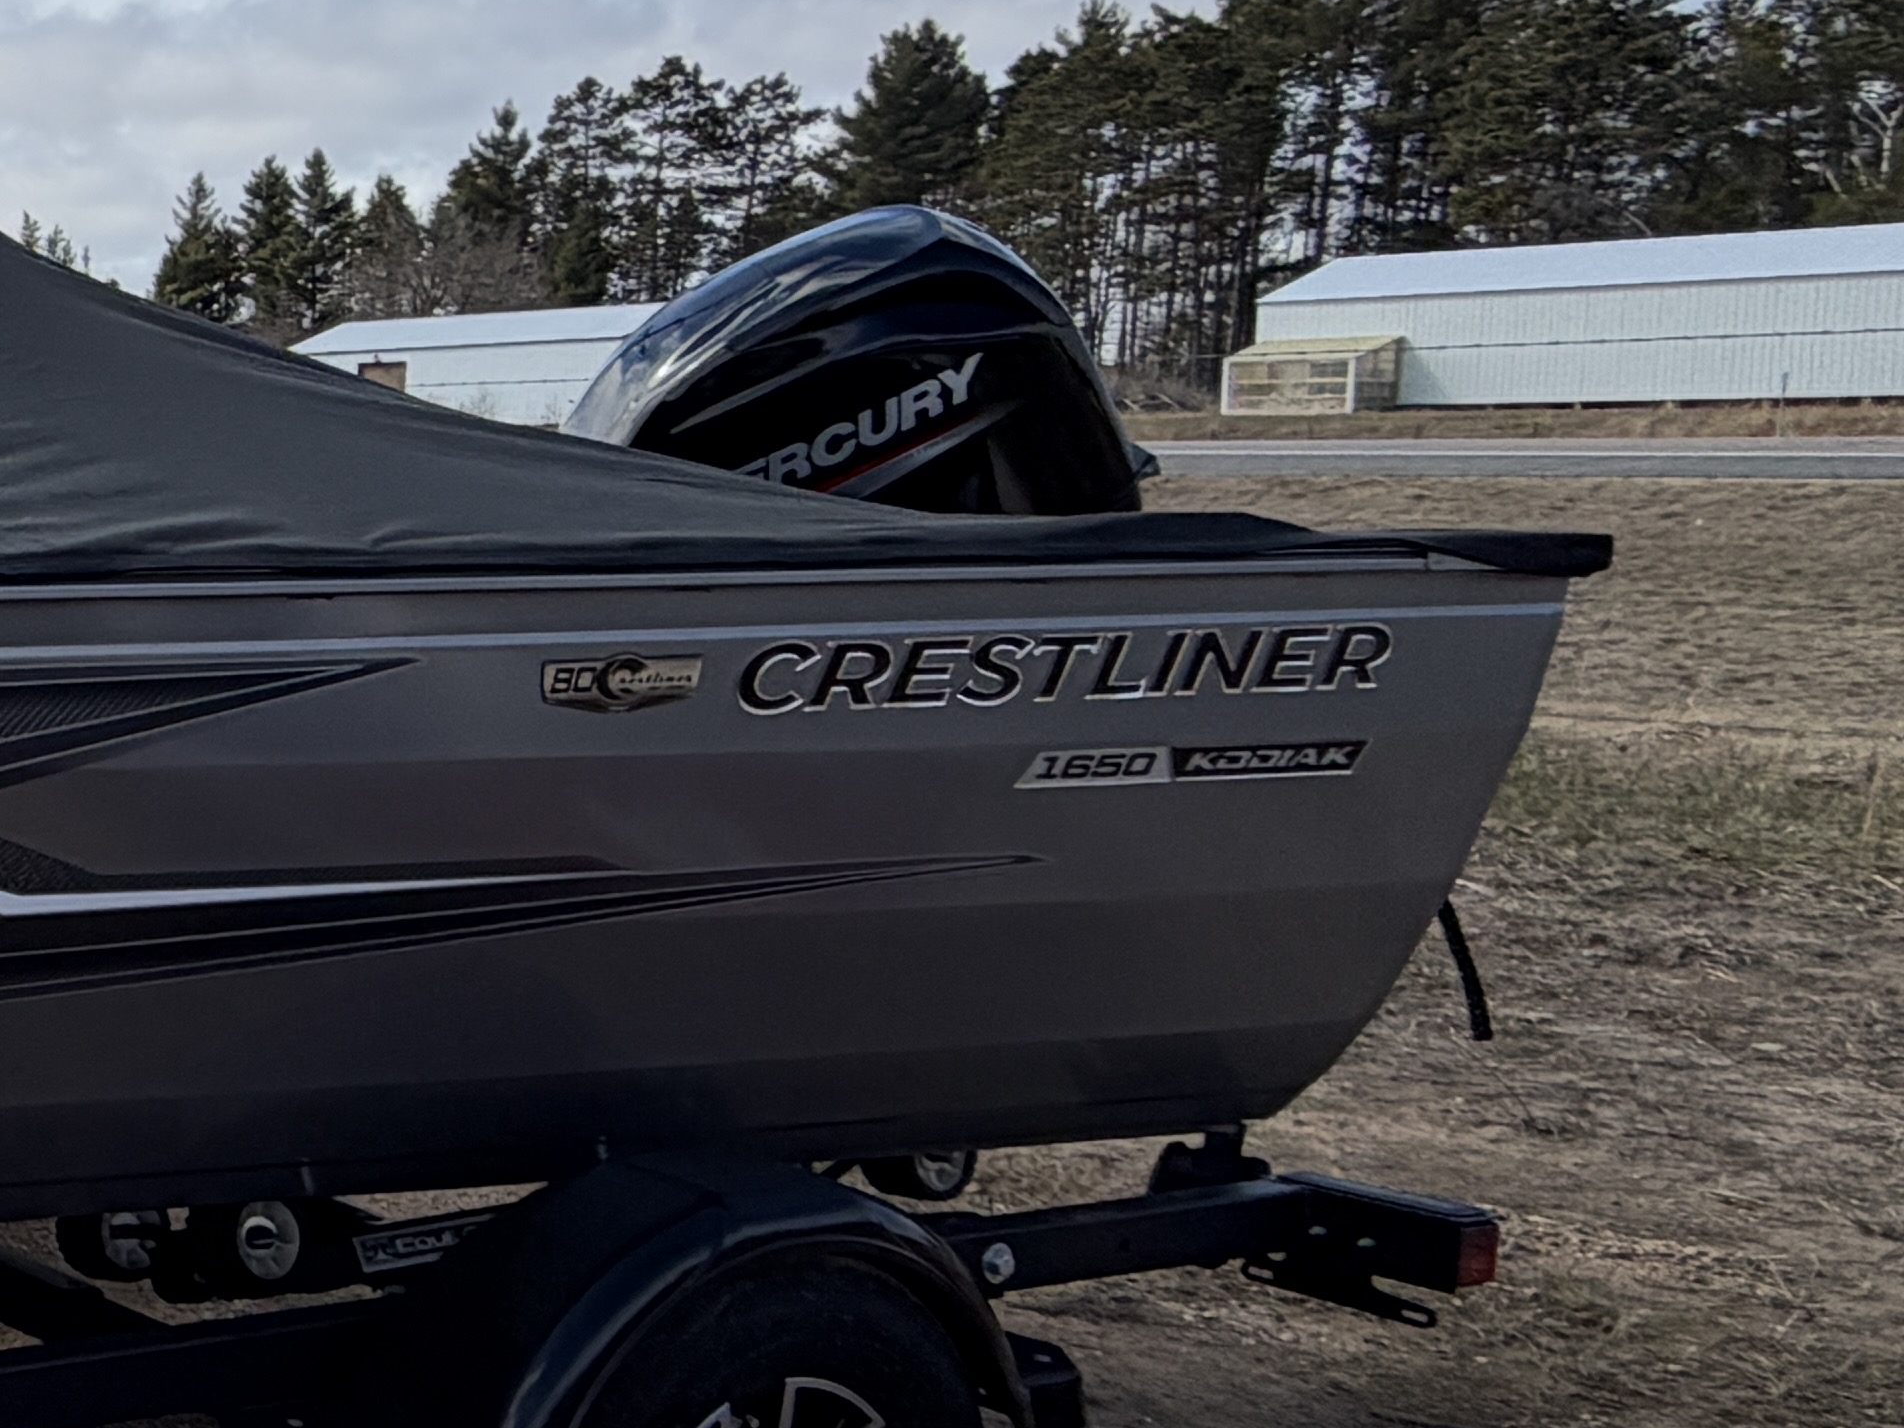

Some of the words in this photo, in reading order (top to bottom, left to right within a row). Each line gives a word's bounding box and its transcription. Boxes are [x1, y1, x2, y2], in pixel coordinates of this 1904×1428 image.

[735, 352, 983, 483] RCURY
[738, 623, 1392, 716] CRESTLINER
[1035, 752, 1158, 779] 1650
[1184, 746, 1356, 771] KODIAK
